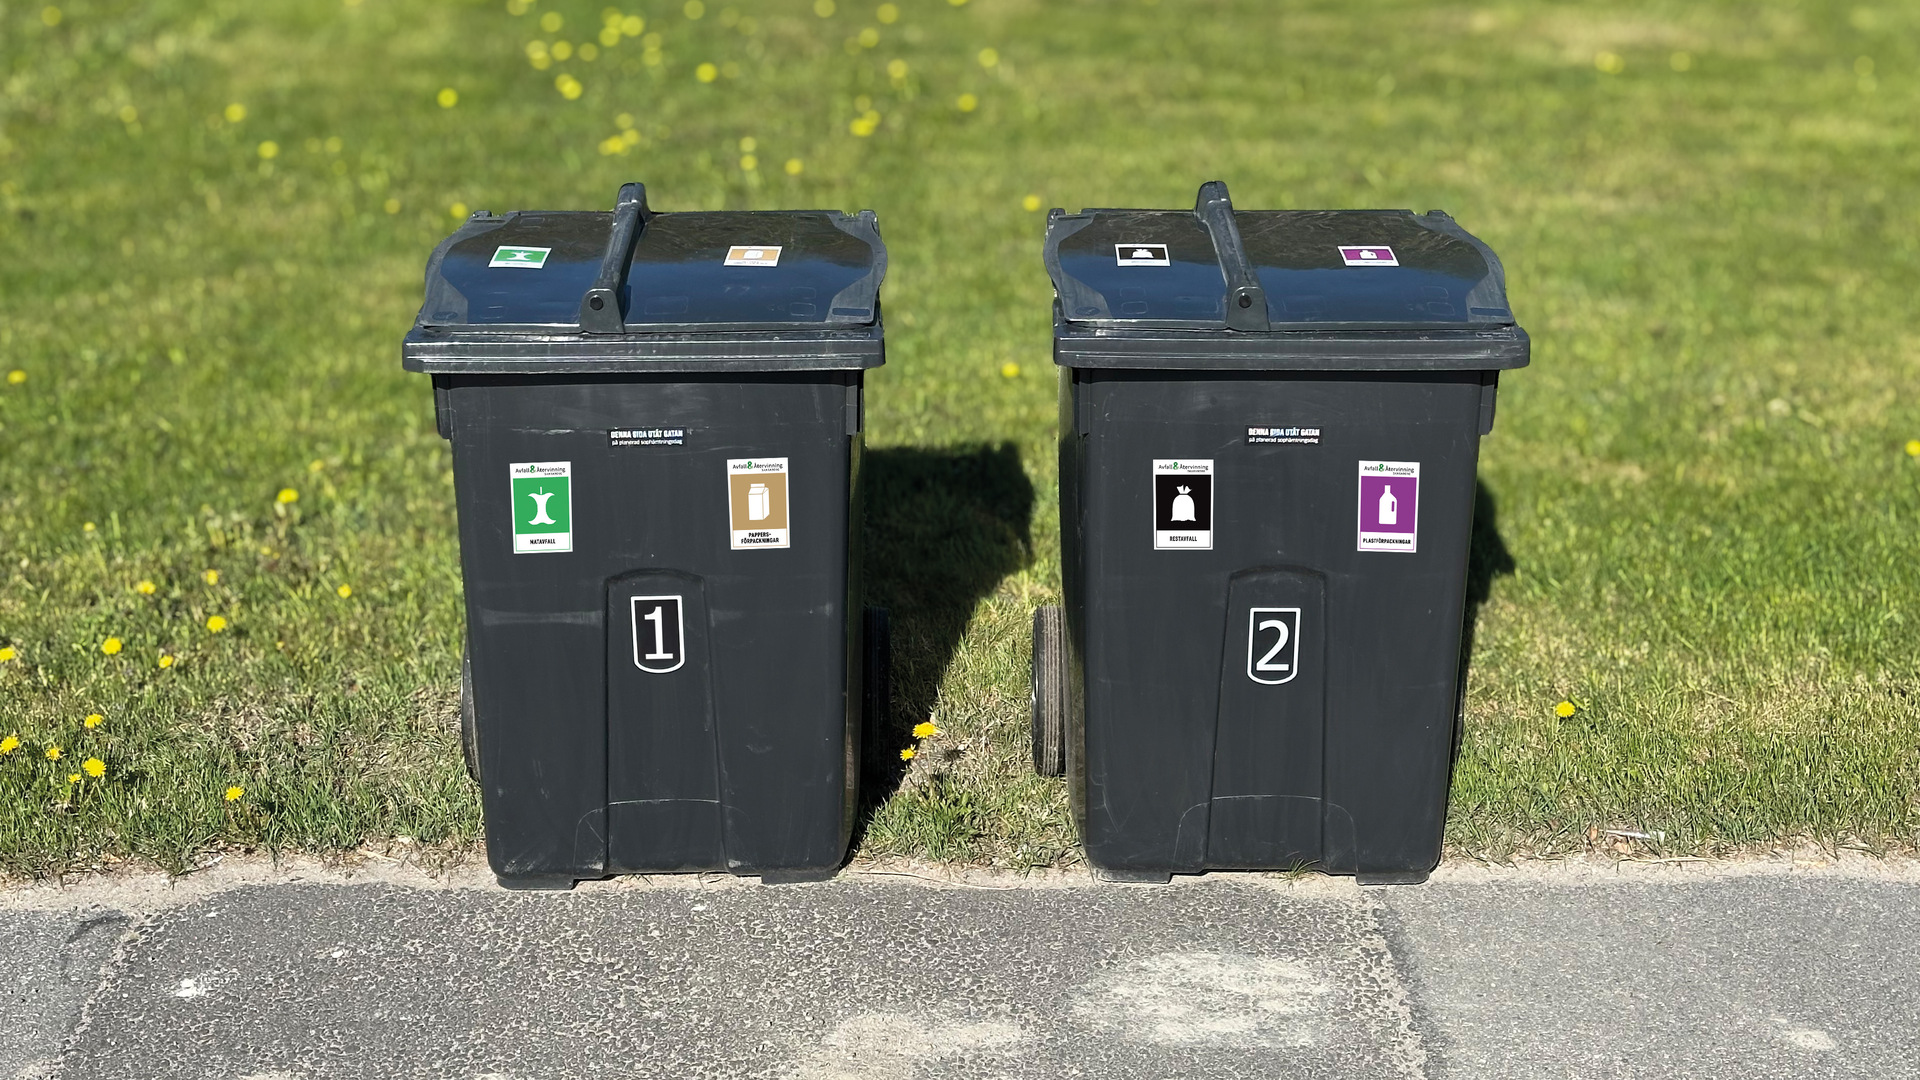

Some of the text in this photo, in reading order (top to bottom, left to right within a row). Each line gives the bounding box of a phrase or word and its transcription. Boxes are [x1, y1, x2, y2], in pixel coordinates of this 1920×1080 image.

[610, 428, 683, 438] DENNA SIDA UTÅT GATAN
[1248, 427, 1320, 436] DENNA SIDA UTÅT GATAN
[530, 465, 536, 473] &
[747, 461, 753, 469] &
[1173, 461, 1179, 470] &
[1378, 463, 1384, 472] &
[1385, 465, 1414, 473] Återvinning
[644, 606, 673, 660] 1
[1256, 619, 1289, 671] 2
